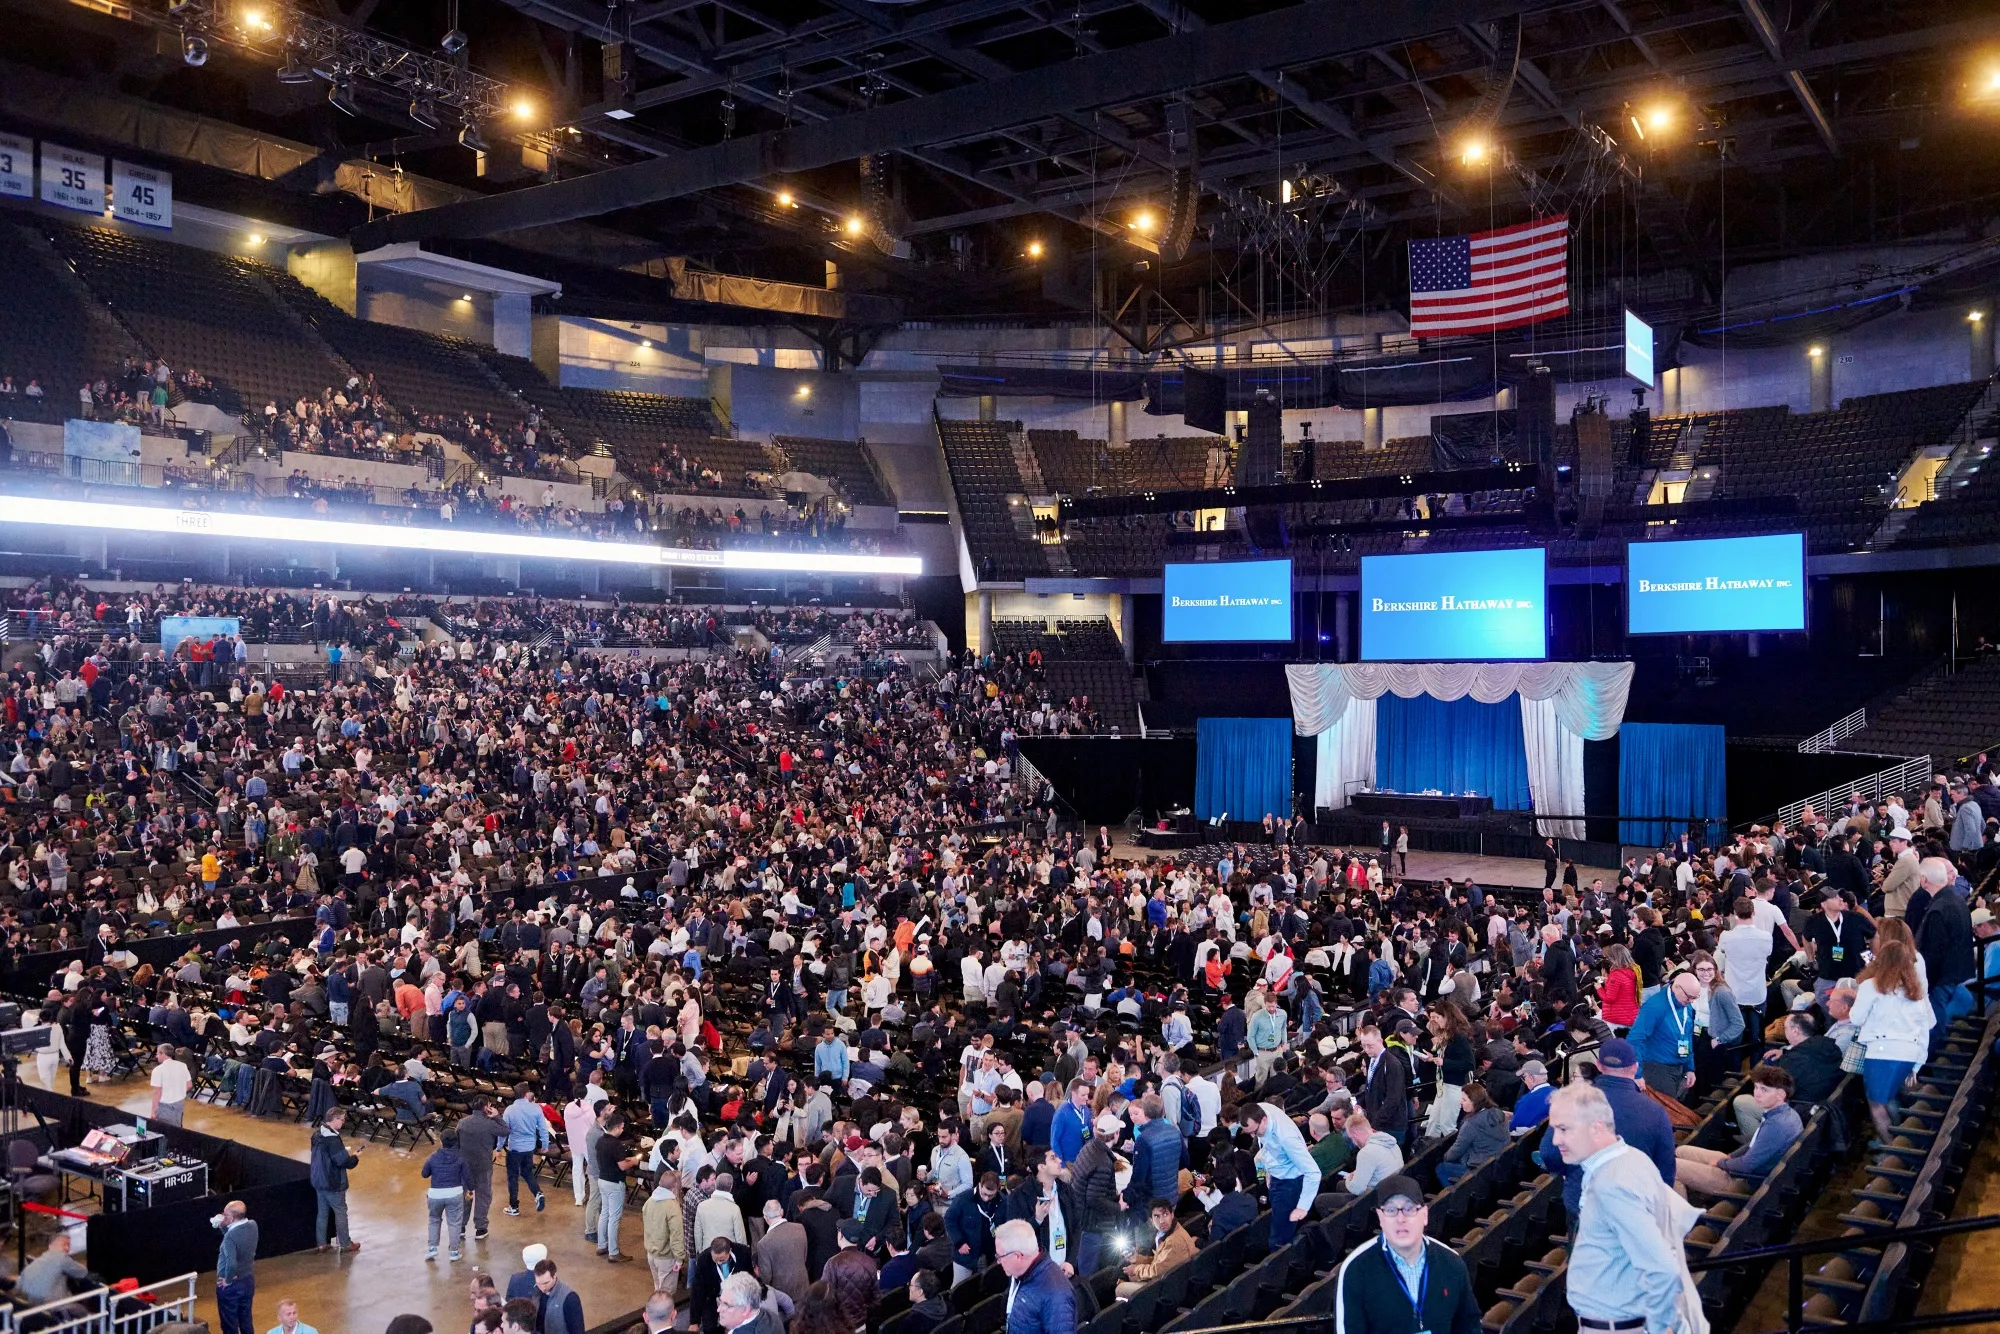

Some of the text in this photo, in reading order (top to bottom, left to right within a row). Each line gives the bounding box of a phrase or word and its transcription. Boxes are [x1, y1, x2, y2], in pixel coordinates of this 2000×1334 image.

[61, 167, 86, 190] 35
[129, 169, 157, 182] GIBSON
[132, 185, 155, 206] 45
[123, 206, 139, 216] 1954
[146, 211, 162, 221] 1957
[1840, 356, 1853, 364] 230
[176, 516, 208, 528] THREE
[1638, 576, 1793, 593] BERKSHIRE HATHAWAY INC.
[1171, 596, 1218, 607] BERKSHIRE
[1220, 595, 1269, 606] HATHAWAY
[1371, 595, 1534, 612] BERKSHIRE HATHAWAY INC.
[401, 646, 413, 655] 122
[164, 1172, 193, 1188] HR-02
